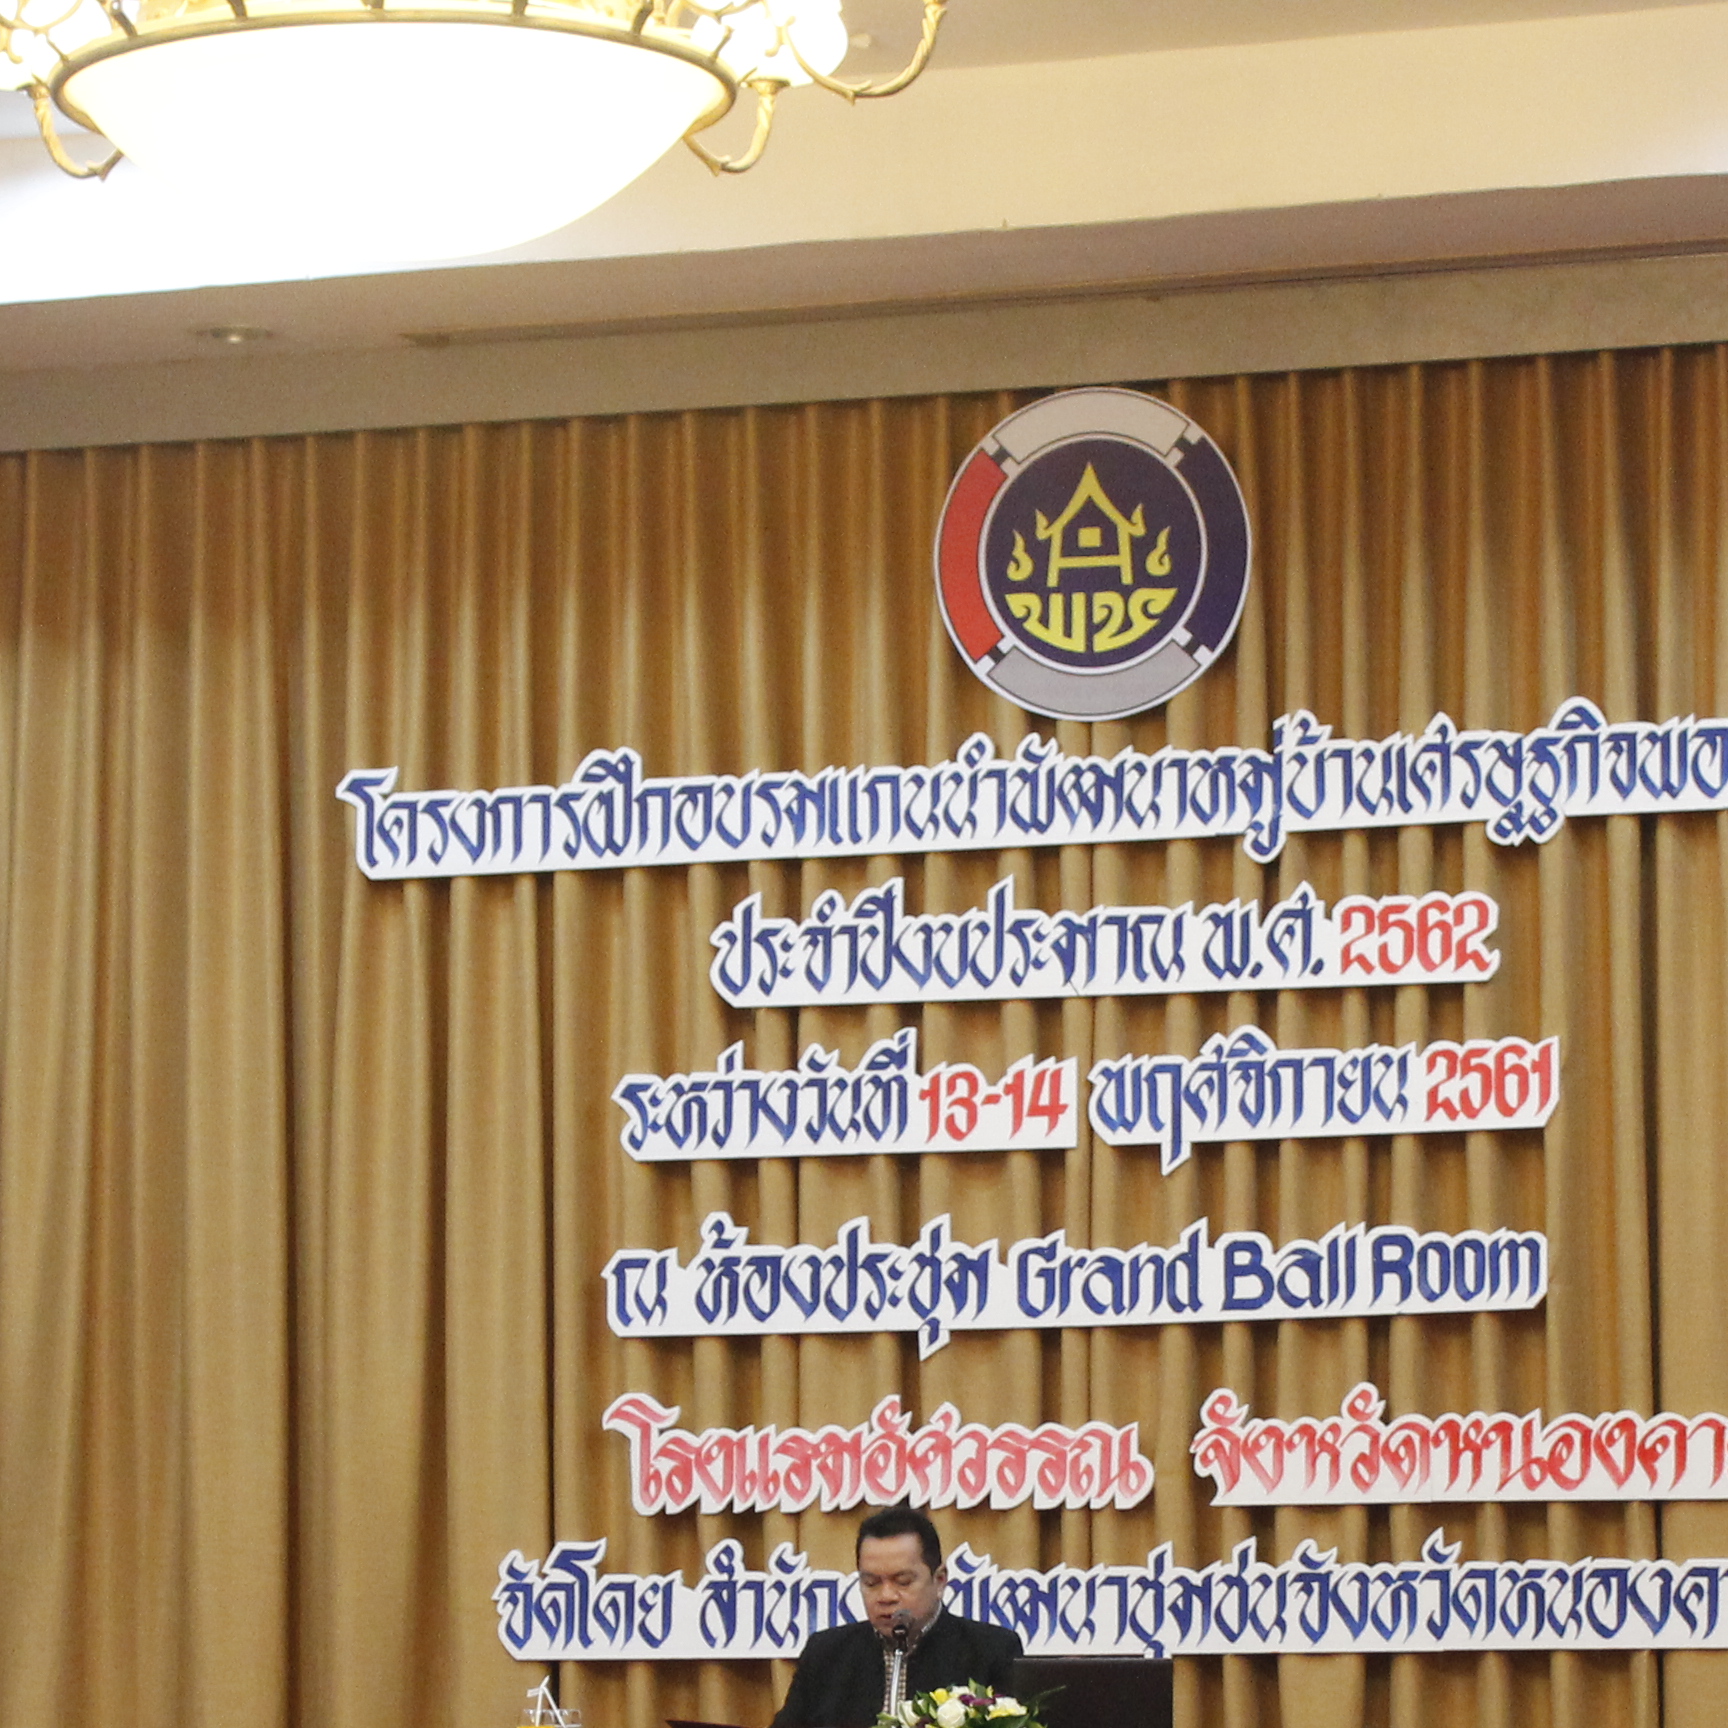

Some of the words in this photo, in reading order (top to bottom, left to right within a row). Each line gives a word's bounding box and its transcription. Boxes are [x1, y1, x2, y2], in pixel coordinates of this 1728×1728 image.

[718, 884, 1186, 996] ประจำปีงบประมาณ
[1203, 892, 1325, 980] พ.ศ.
[1339, 898, 1494, 976] 2562
[917, 1058, 1070, 1142] 13-14
[1096, 1033, 1409, 1161] พฤศจิกายน
[1422, 1040, 1554, 1122] 2561
[612, 1257, 669, 1327] ณ
[695, 1220, 992, 1345] ห้องประชุม
[1017, 1233, 1205, 1319] Grand
[1222, 1234, 1358, 1312] Ball
[1371, 1233, 1541, 1304] Room
[608, 1397, 1148, 1506] โรงแรมอัศวรรณ
[503, 1543, 674, 1650] จัดโดย
